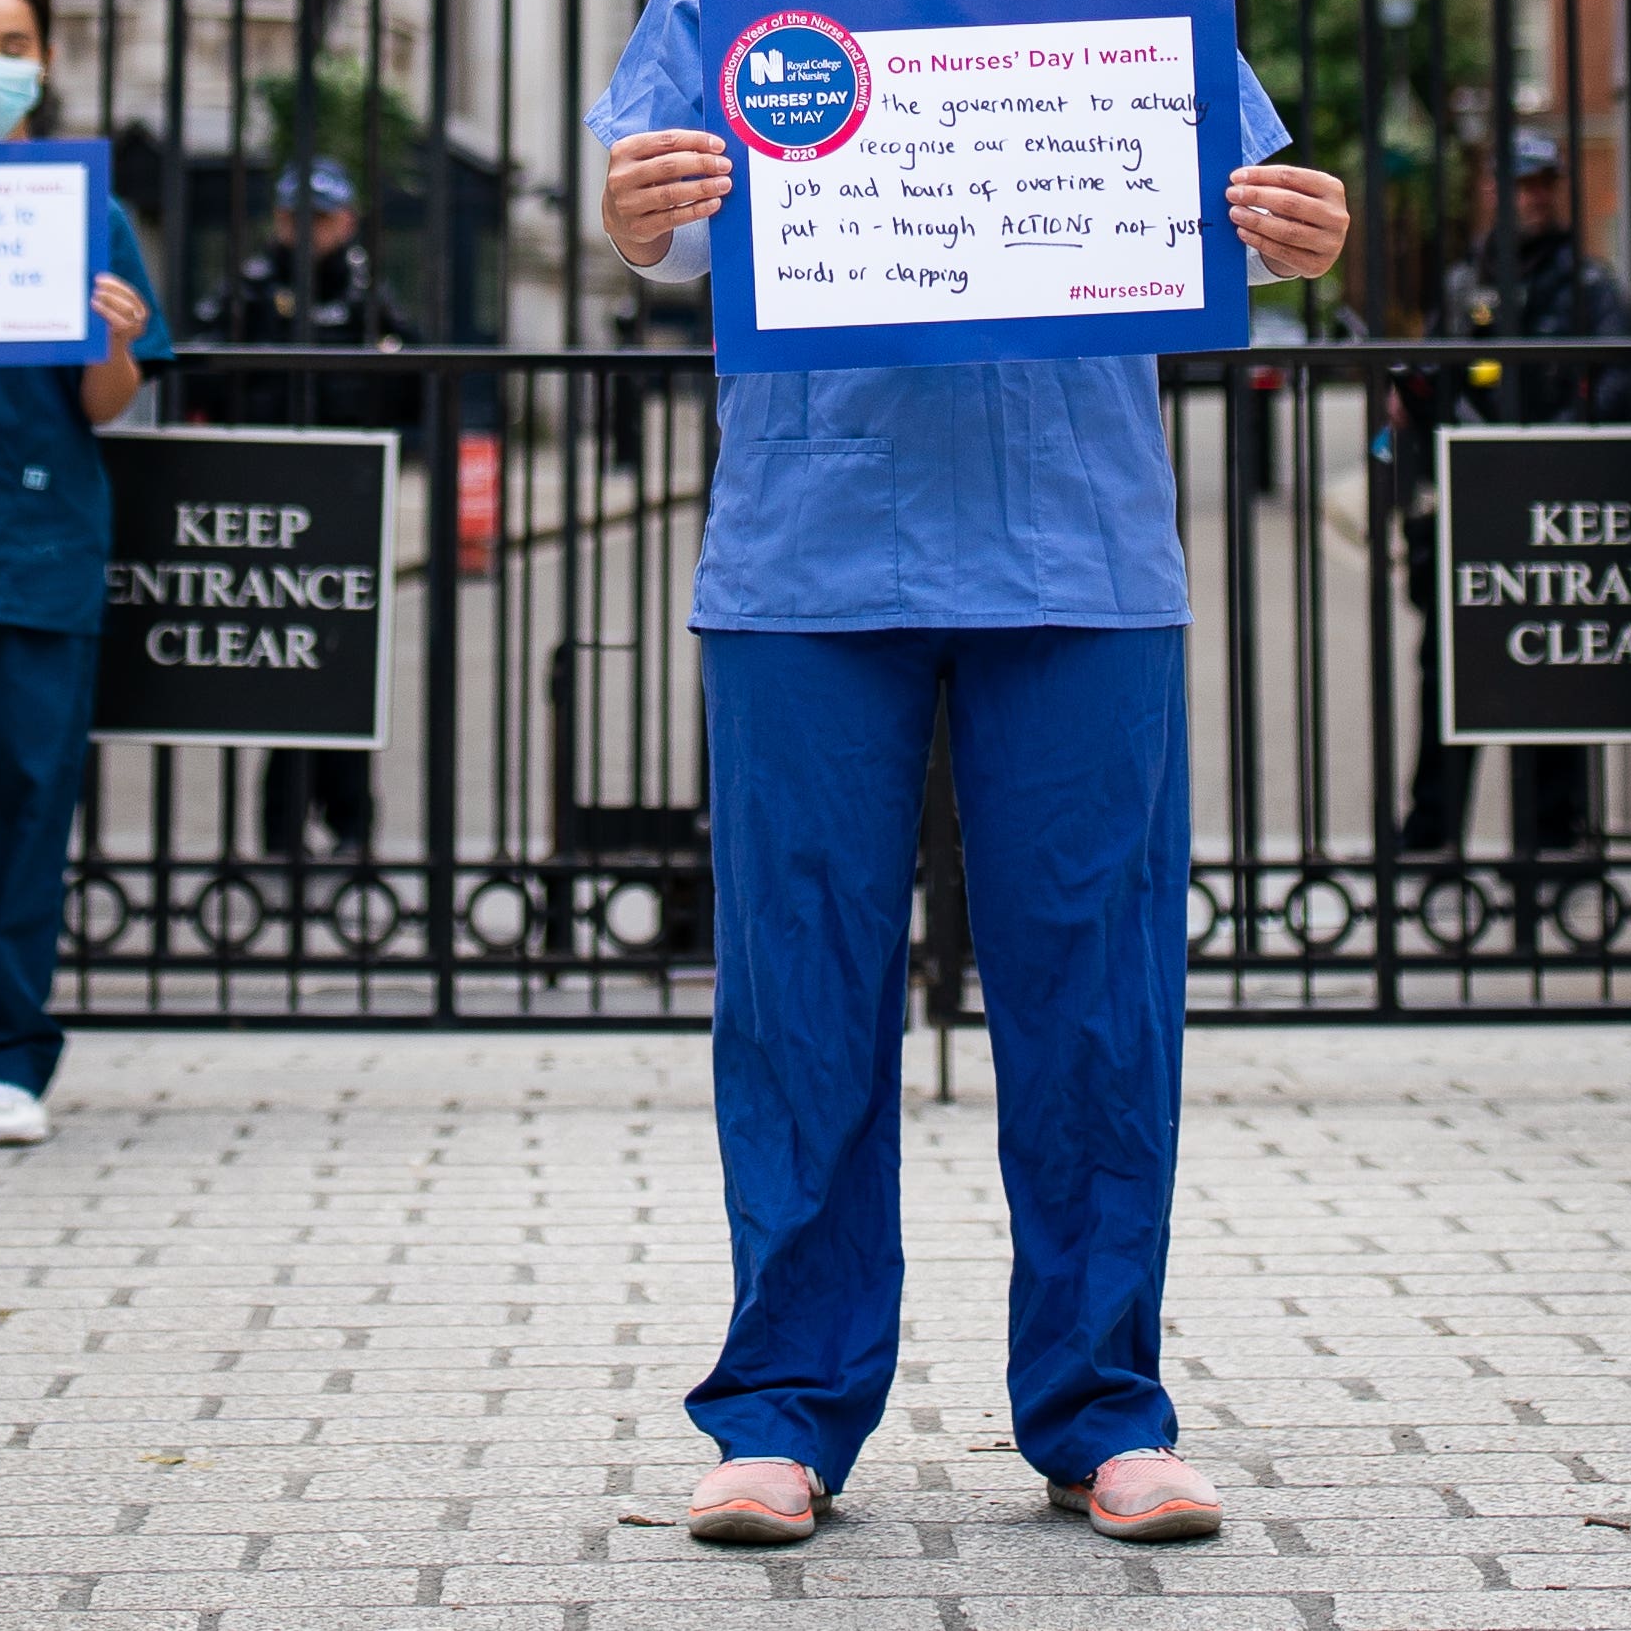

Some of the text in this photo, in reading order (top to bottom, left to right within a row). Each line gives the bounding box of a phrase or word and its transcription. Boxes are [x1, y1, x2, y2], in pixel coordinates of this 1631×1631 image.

[724, 14, 870, 120] International Year of the Nurse and Midwife
[787, 59, 842, 72] Royal College
[888, 46, 1178, 74] On Nurses’ Day I want...
[787, 71, 830, 83] of Nursing
[745, 91, 848, 109] NURSES’ DAY
[882, 93, 1210, 127] the government to actually
[771, 110, 824, 125] 12 MAY
[782, 148, 817, 161] 2020
[859, 134, 1143, 171] recognise our exhausting
[780, 175, 1160, 209] job and hours of overtime we
[781, 219, 819, 245] put
[839, 219, 859, 235] in
[893, 216, 976, 249] through
[1001, 214, 1093, 236] ACTIONS
[1115, 220, 1157, 236] not
[1166, 216, 1213, 248] just
[778, 261, 968, 294] words or clapping
[1069, 282, 1185, 300] #NursesDay
[174, 502, 312, 549] KEEP
[145, 621, 319, 668] CLEAR
